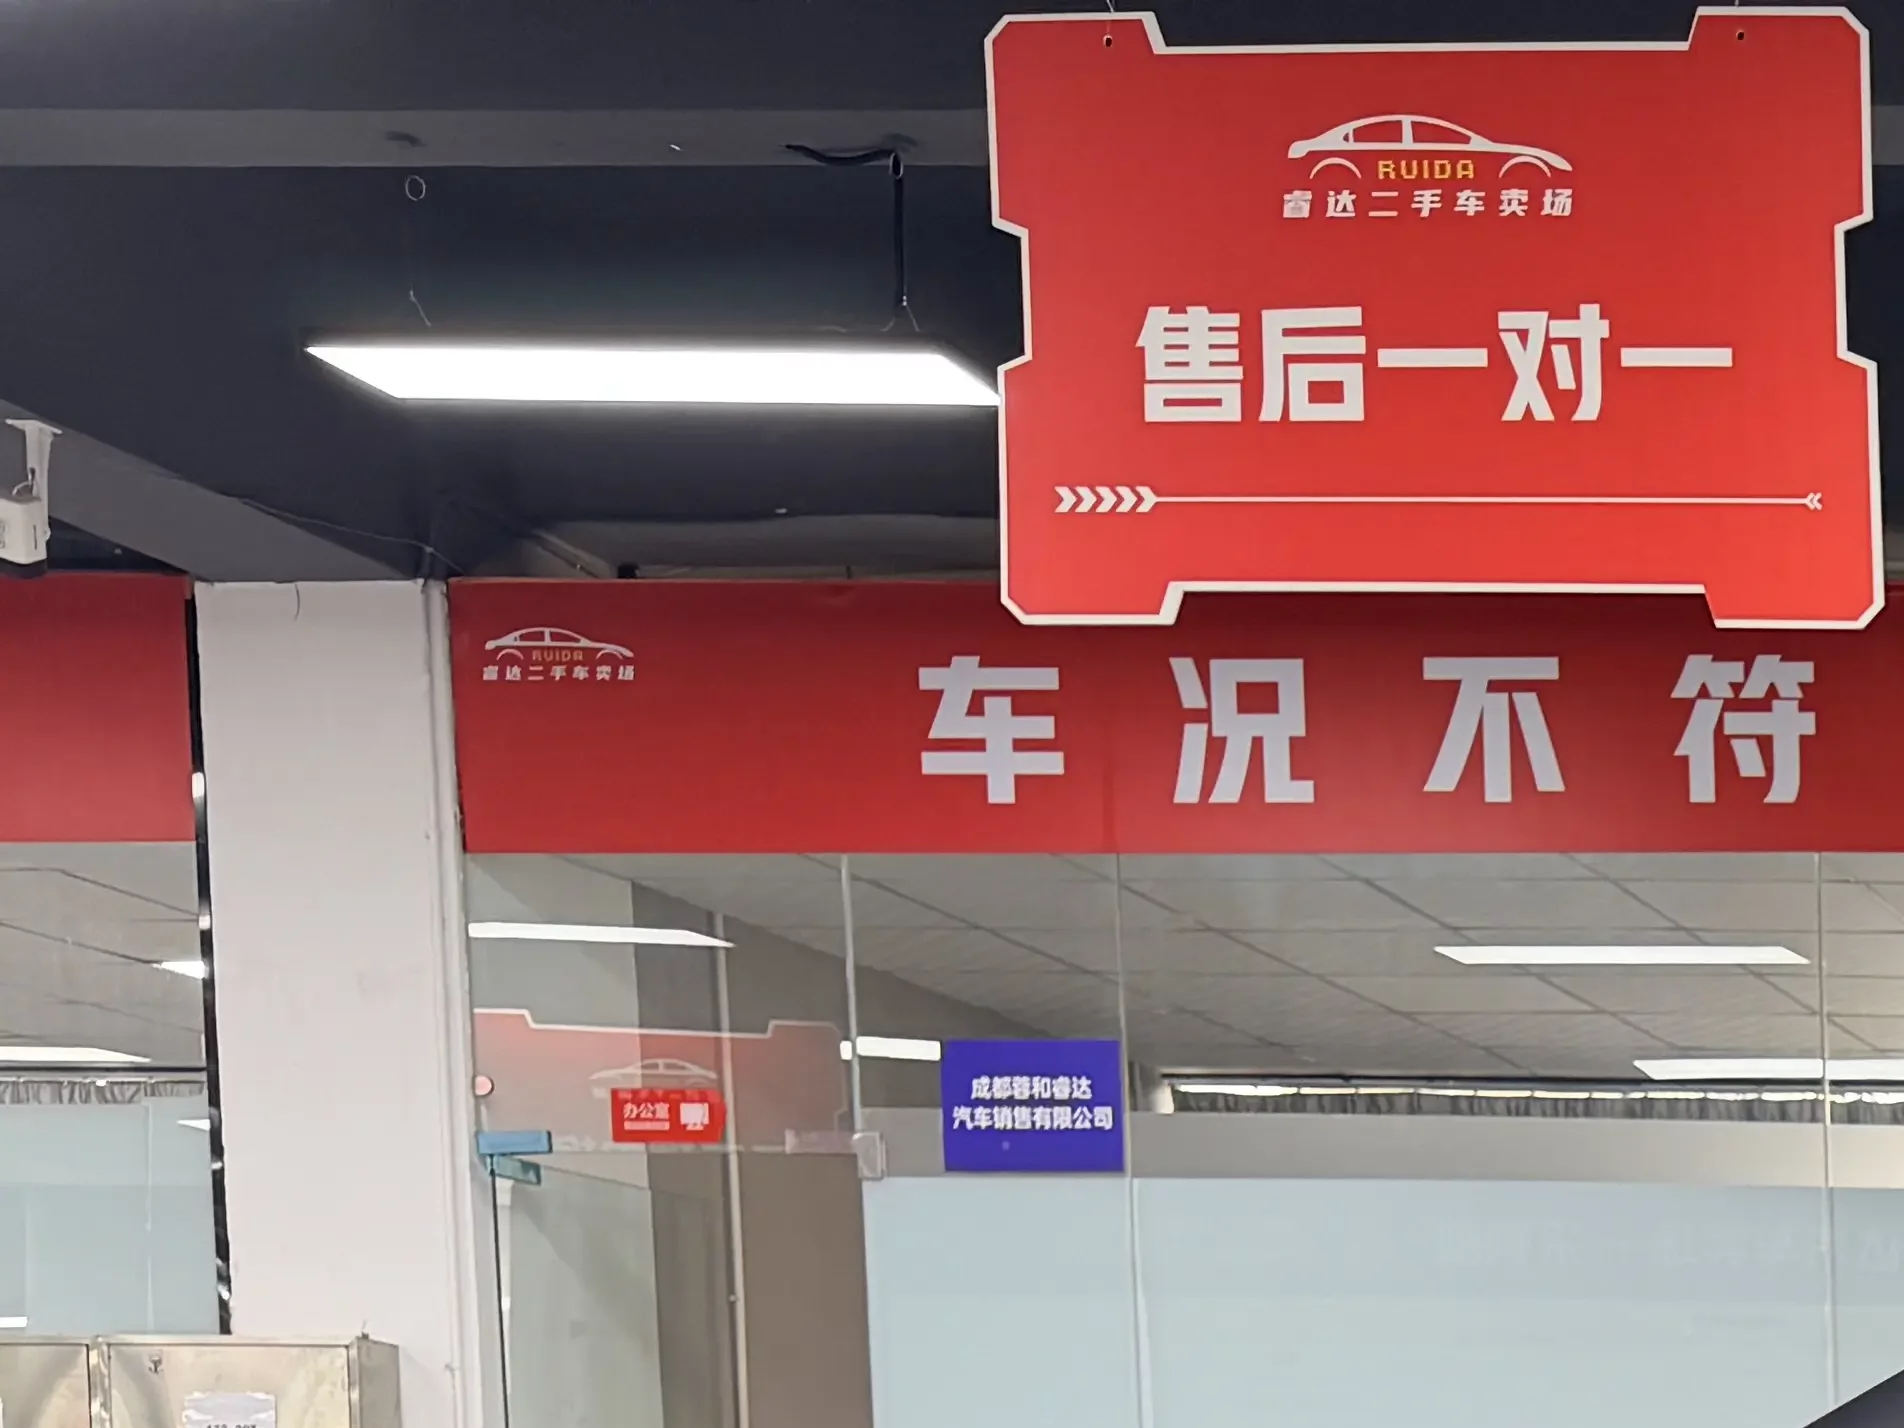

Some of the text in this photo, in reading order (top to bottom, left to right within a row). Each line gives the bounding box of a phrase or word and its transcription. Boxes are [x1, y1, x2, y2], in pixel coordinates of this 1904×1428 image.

[1377, 159, 1475, 180] RUIDA
[1282, 188, 1573, 218] 睿达二手车卖场
[1136, 303, 1733, 423] 售后一对一
[918, 654, 1816, 804] 车况不符
[623, 1102, 670, 1119] 办公室
[952, 1105, 1113, 1130] 汽车销售有限公司
